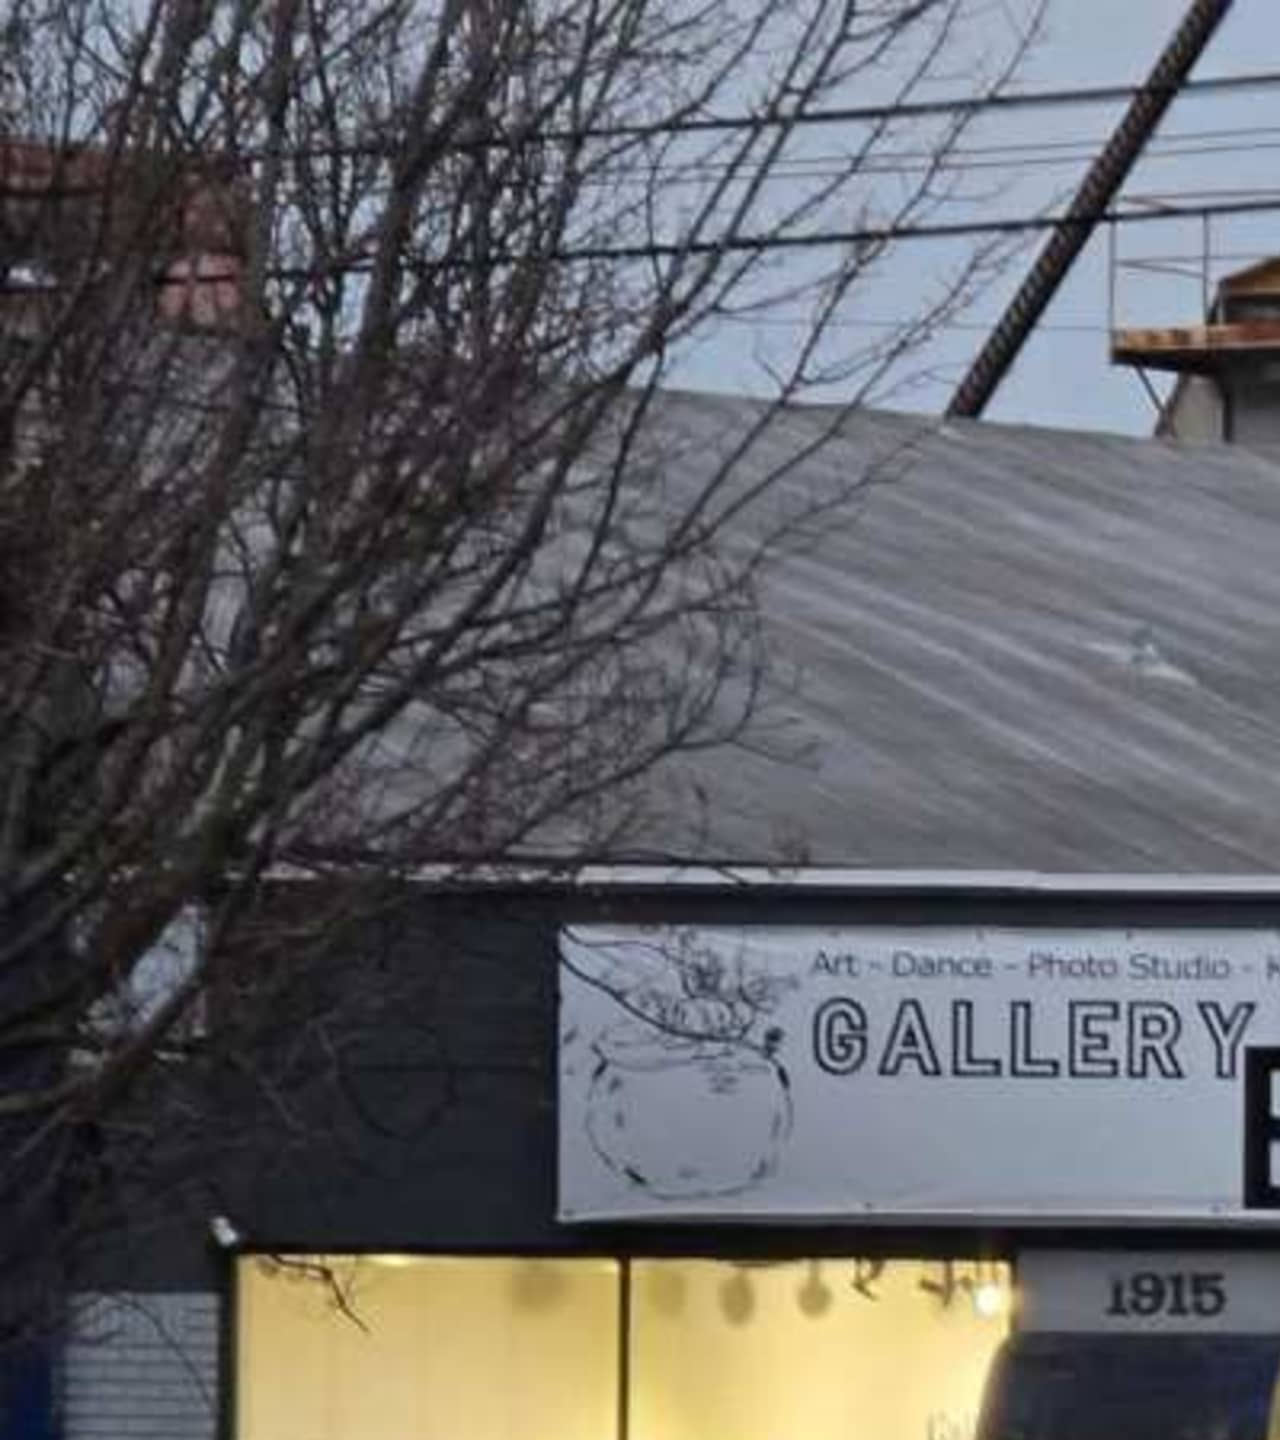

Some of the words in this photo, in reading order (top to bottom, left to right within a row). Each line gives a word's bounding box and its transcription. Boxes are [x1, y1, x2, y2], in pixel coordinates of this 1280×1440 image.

[811, 951, 859, 978] Art
[891, 952, 992, 979] Dance
[1028, 952, 1118, 979] Photo
[1128, 952, 1231, 981] Studio
[812, 996, 1257, 1079] GALLERY
[1105, 1271, 1228, 1318] 1915
